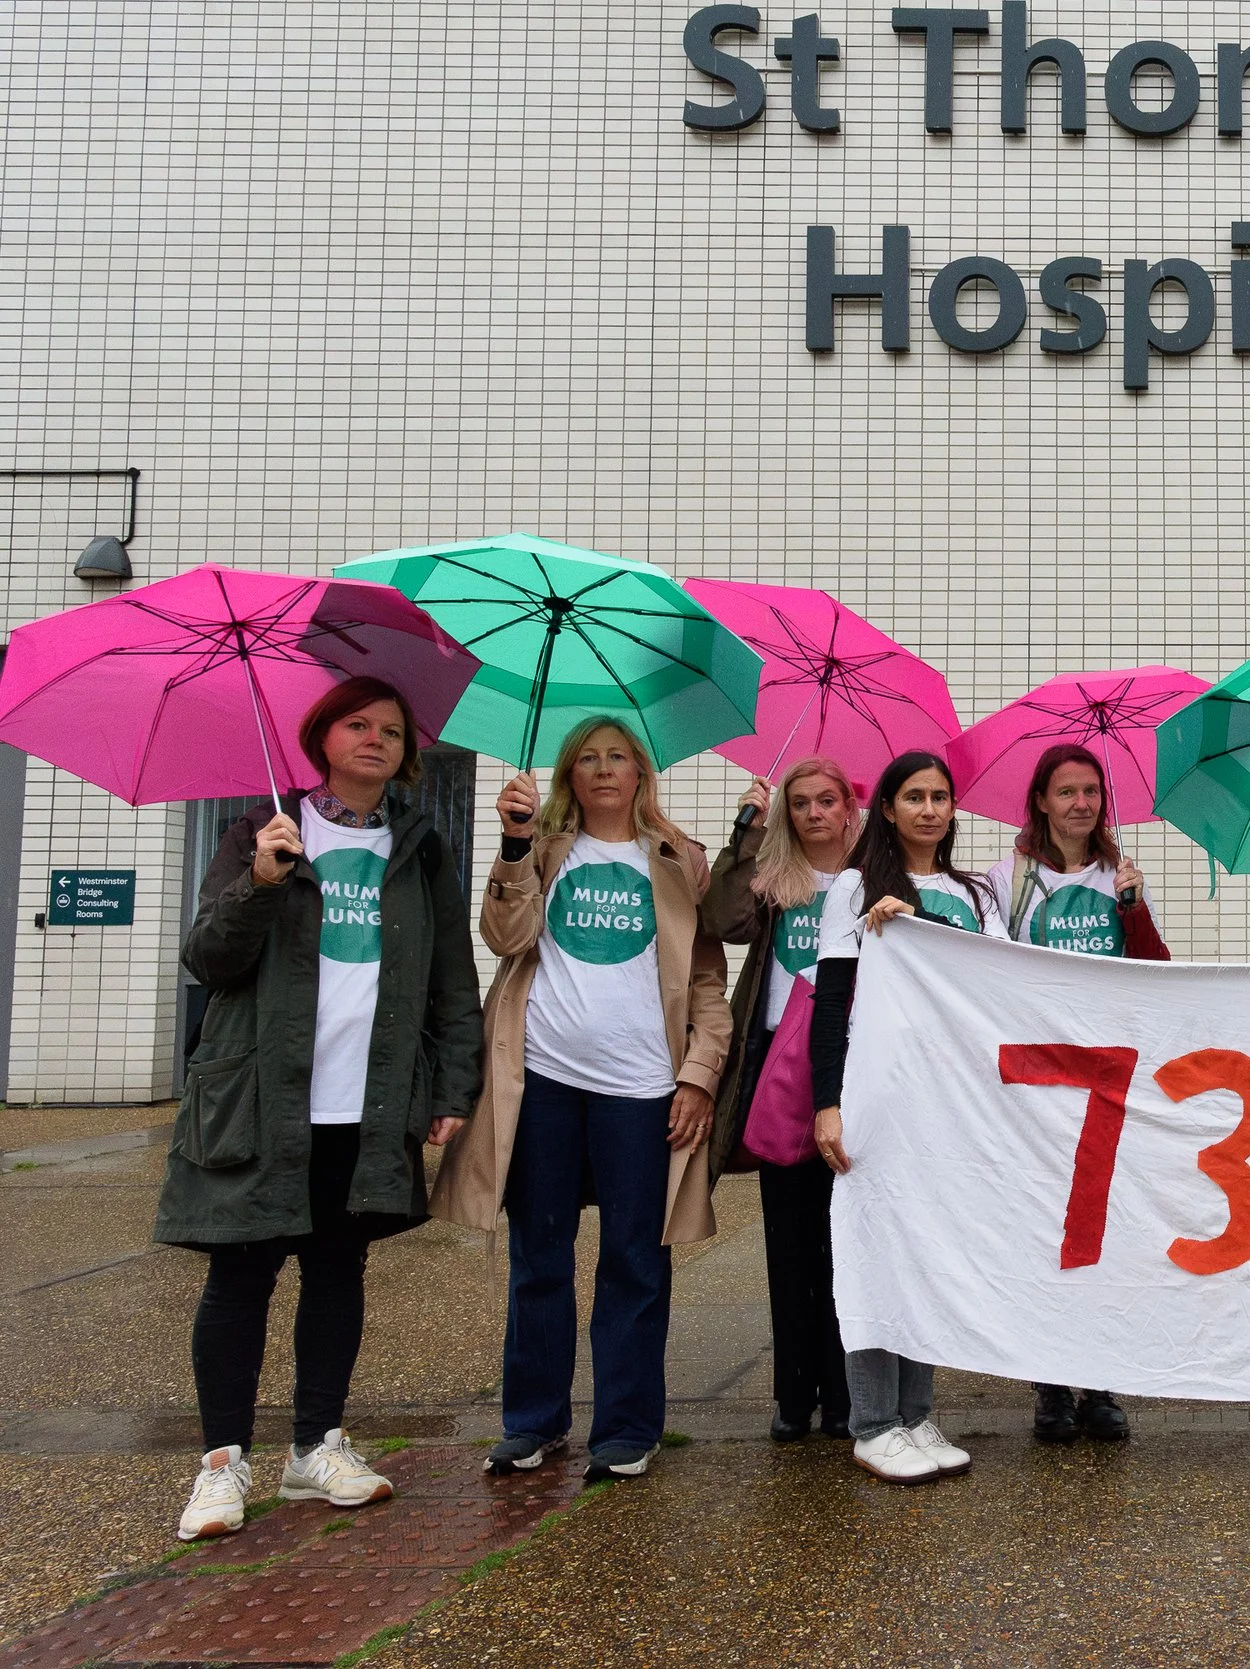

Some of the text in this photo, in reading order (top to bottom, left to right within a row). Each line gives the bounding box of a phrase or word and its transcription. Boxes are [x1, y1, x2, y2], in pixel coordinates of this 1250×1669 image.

[682, 3, 841, 135] St
[78, 877, 128, 885] Westminster
[77, 888, 103, 897] Bridge
[572, 887, 642, 907] MUMS
[77, 899, 119, 908] Consulting
[347, 900, 369, 909] FOR
[596, 904, 617, 912] FOR
[76, 910, 103, 918] Rooms
[322, 907, 382, 926] UNG
[566, 911, 643, 932] LUNGS
[1049, 913, 1110, 930] MUMS
[1072, 929, 1090, 937] FOR
[1048, 936, 1115, 952] LUNGS
